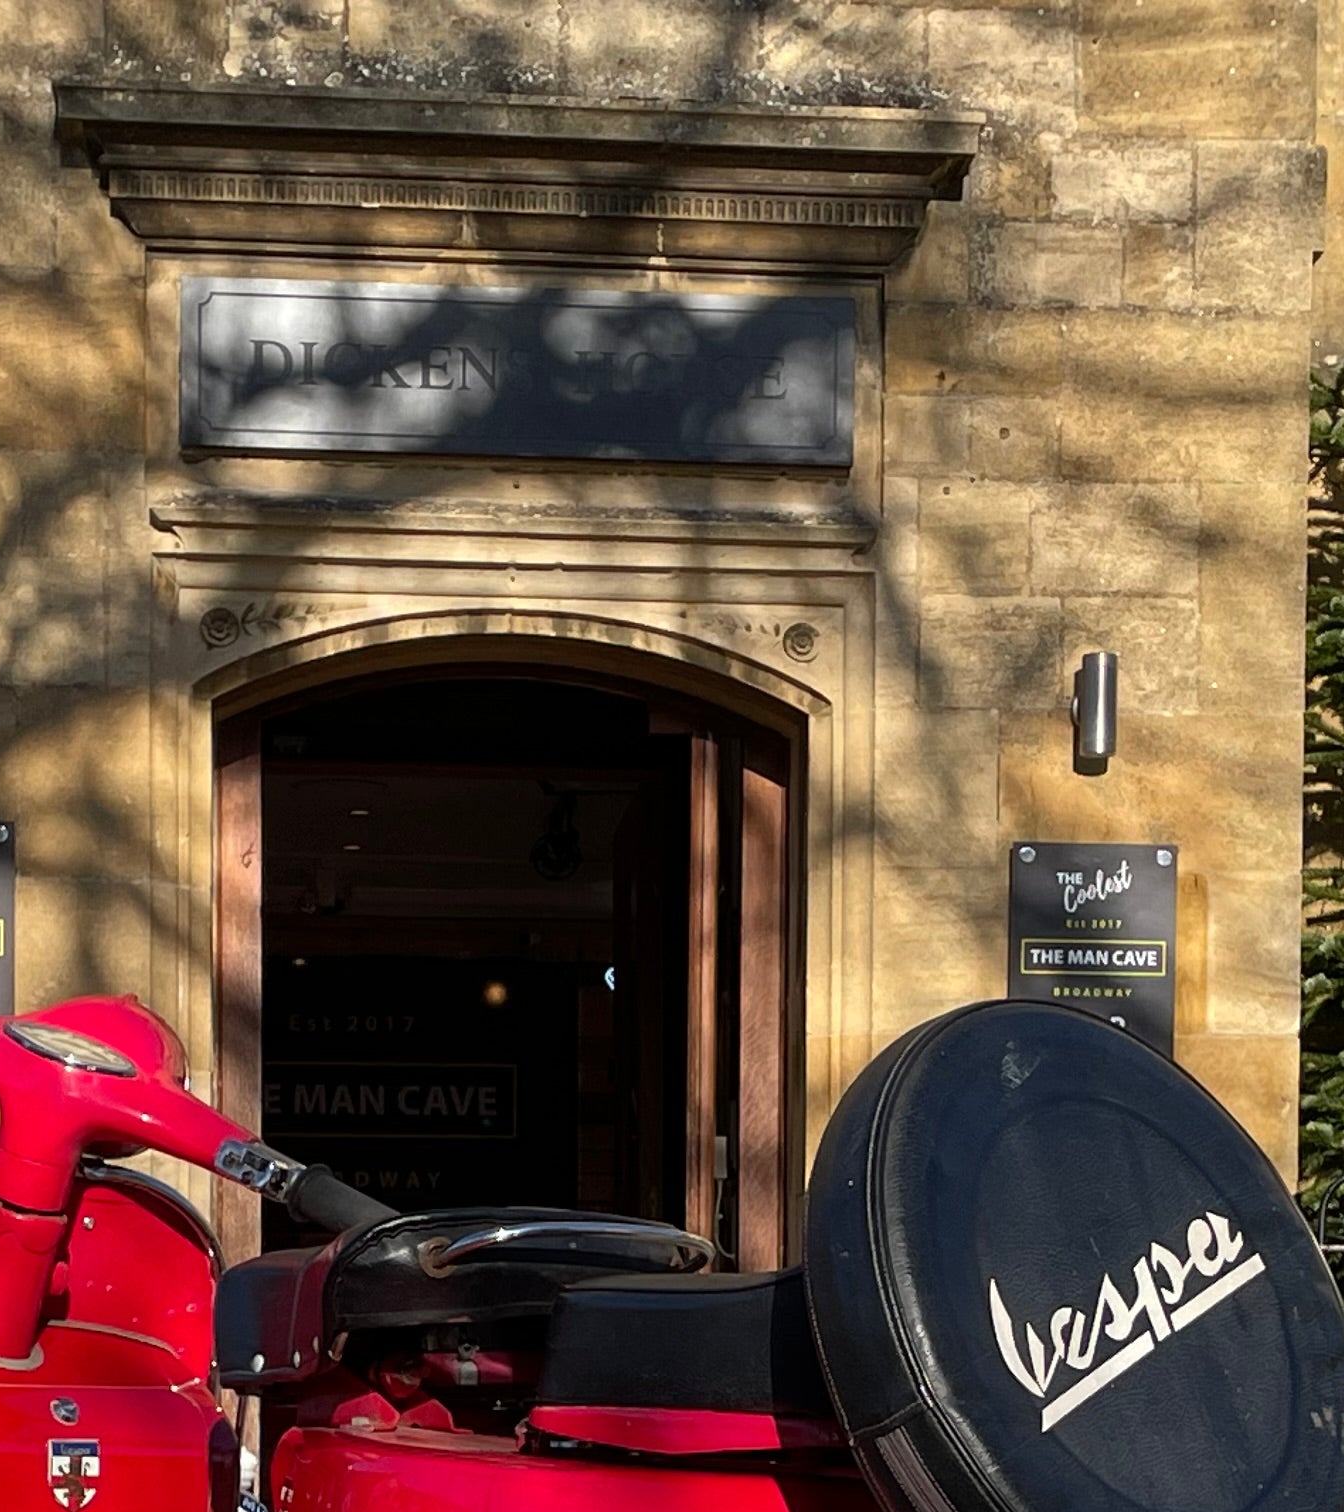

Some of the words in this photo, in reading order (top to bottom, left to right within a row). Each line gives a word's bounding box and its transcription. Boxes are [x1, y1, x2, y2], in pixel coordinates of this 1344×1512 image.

[249, 338, 534, 395] DICKENS
[1055, 871, 1084, 885] THE
[1063, 859, 1133, 914] Coolest
[1029, 948, 1064, 965] THE
[1067, 949, 1109, 966] MAN
[1111, 950, 1158, 967] CAVE
[1052, 986, 1133, 998] BROADWAY
[288, 1012, 332, 1032] Est
[346, 1014, 416, 1033] 2017
[293, 1083, 386, 1115] MAN
[396, 1085, 498, 1117] CAVE
[339, 1170, 442, 1190] DWAY
[988, 1210, 1253, 1412] Vespa
